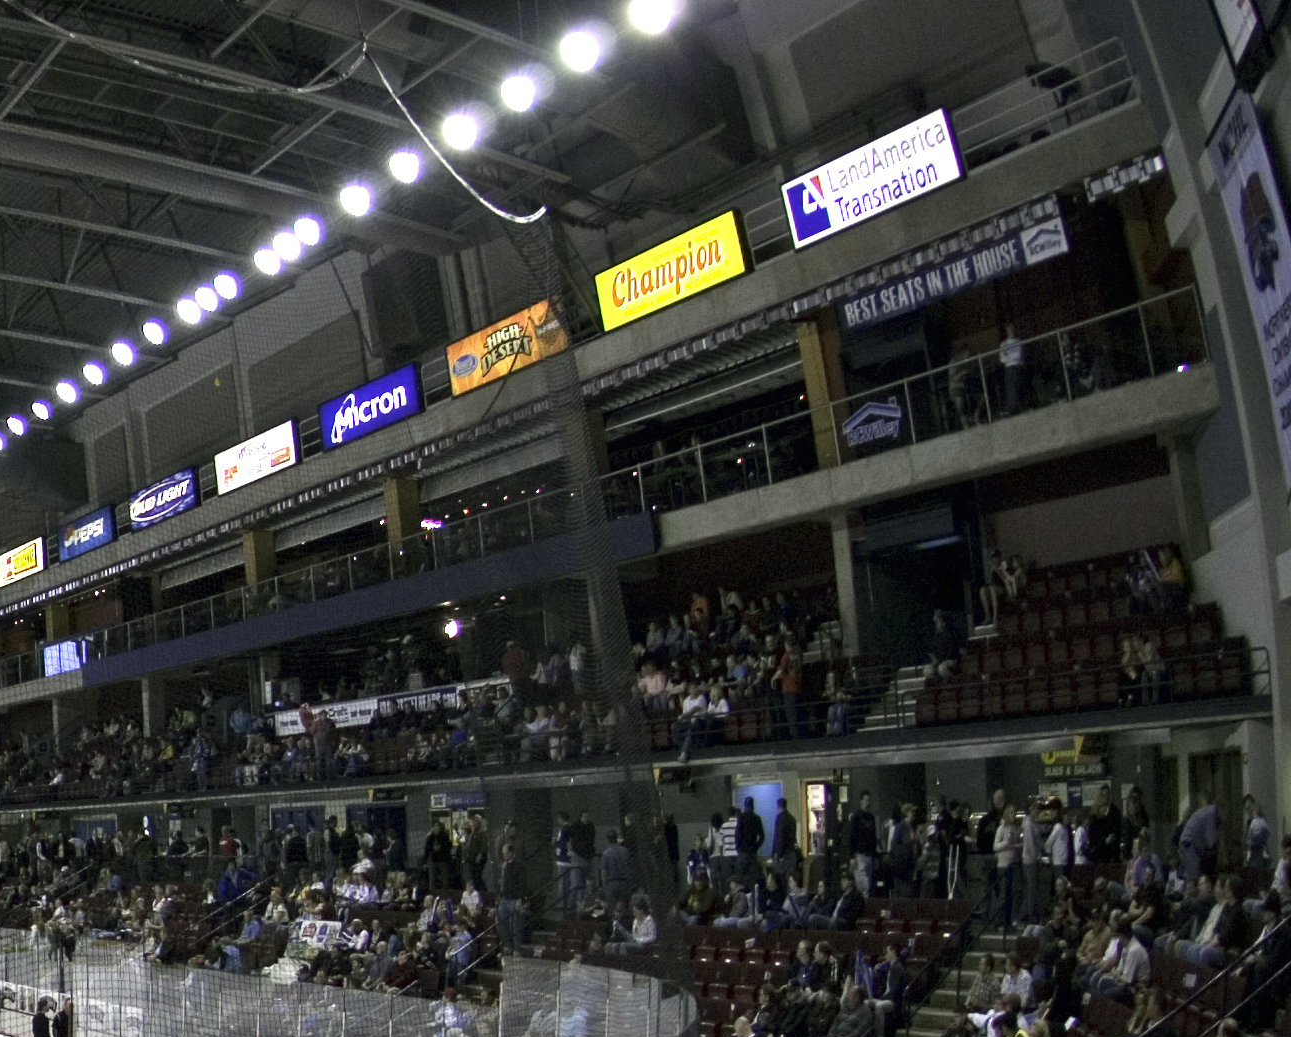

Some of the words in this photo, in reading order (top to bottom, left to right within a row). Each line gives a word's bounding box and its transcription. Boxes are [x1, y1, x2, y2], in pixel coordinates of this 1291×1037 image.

[827, 123, 946, 192] LandAmerica
[834, 163, 938, 222] Transnation
[612, 239, 721, 307] Champion
[844, 294, 880, 328] BEST
[880, 276, 925, 313] SEATS
[926, 269, 944, 297] IN
[944, 258, 971, 290] THE
[972, 239, 1020, 280] HOUSE
[481, 336, 532, 377] DESERT
[485, 323, 523, 351] HIGH
[331, 385, 407, 443] Micron
[129, 496, 156, 517] BUD
[156, 479, 190, 507] LIGHT
[74, 517, 104, 545] PEPSI
